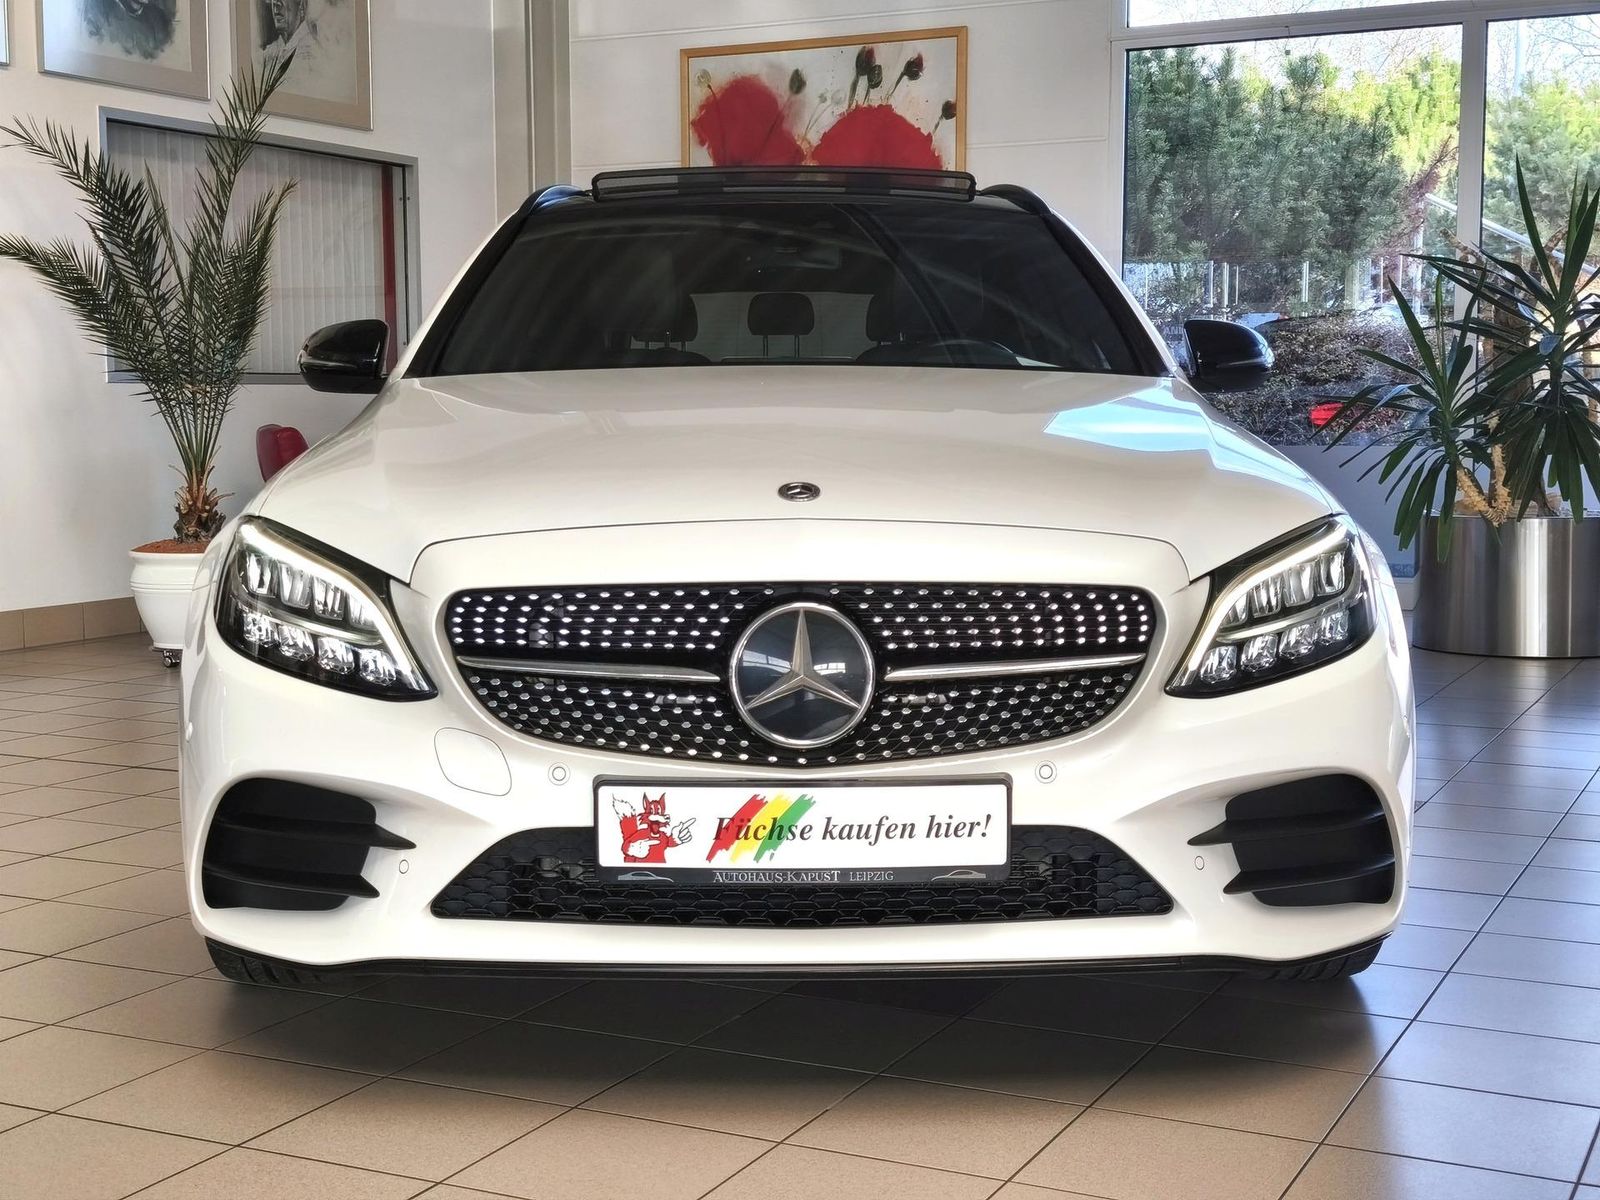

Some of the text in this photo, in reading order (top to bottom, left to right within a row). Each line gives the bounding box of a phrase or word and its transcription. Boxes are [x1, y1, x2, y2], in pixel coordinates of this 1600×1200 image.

[713, 813, 992, 847] Füchse kaufen hier!
[849, 871, 894, 882] LEIPZIG
